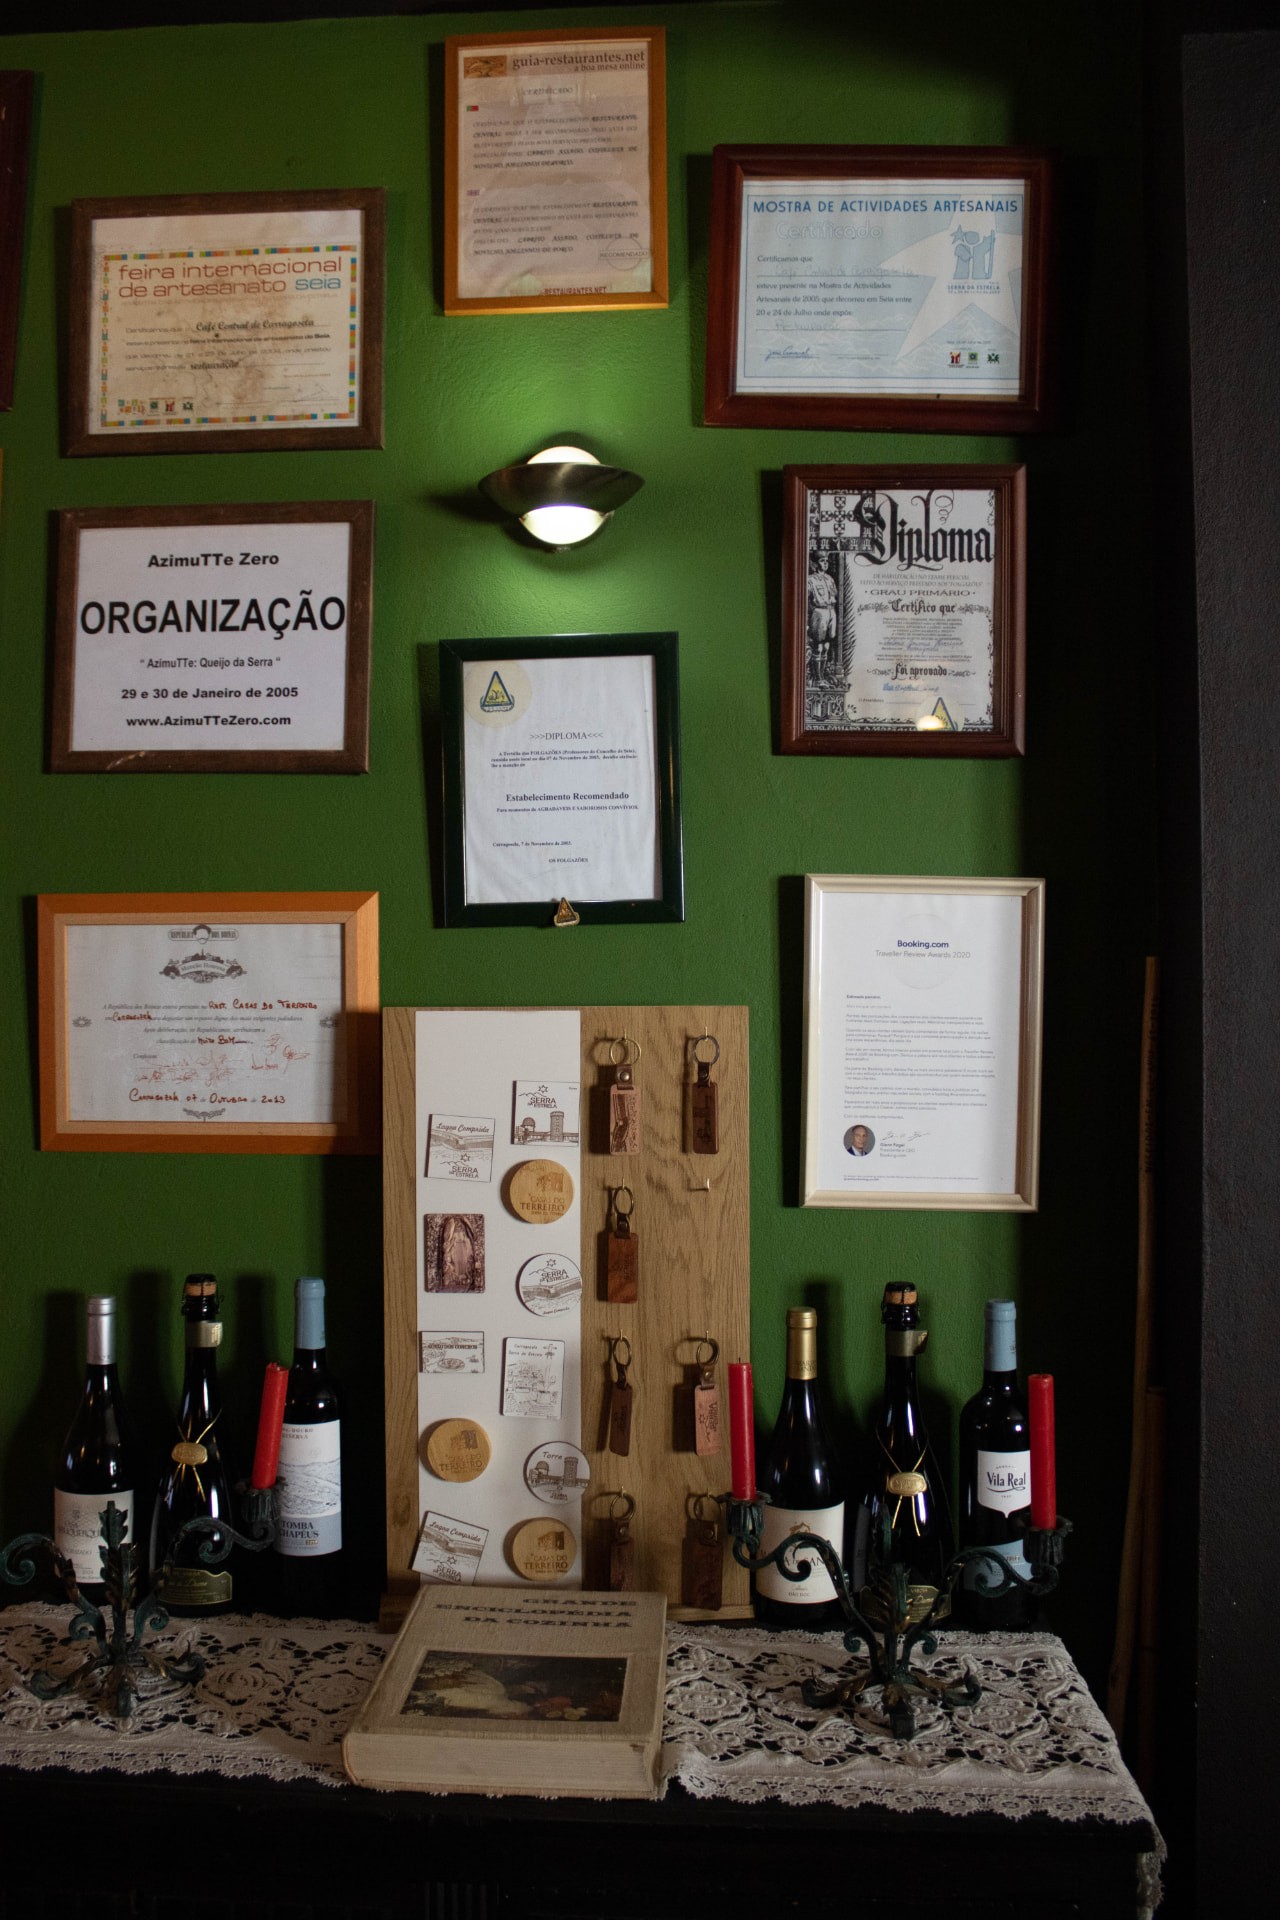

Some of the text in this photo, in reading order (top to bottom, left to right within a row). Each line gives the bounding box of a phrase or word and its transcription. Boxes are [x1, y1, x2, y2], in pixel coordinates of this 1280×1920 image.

[512, 51, 646, 70] guia-restaurantes.net
[619, 62, 646, 70] online
[753, 200, 1018, 213] MOSTRA DE ACTIVIDADES ARTESANAIS
[775, 218, 884, 240] Certificado
[119, 256, 342, 281] feira internacional
[119, 274, 342, 298] de artesanato seia
[778, 283, 806, 291] presente
[196, 320, 217, 332] Café
[217, 319, 249, 331] Central
[853, 490, 993, 571] Diploma
[148, 552, 279, 567] AzimuTTe Zero
[909, 588, 971, 597] PRIMÁRIO
[888, 598, 956, 617] Certifico que
[80, 589, 345, 640] ORGANIZAÇÃO
[147, 656, 273, 669] AzimuTTe: Queijo da Serra
[910, 665, 948, 678] aprovado
[121, 689, 137, 699] 29
[153, 688, 169, 699] 30
[172, 688, 188, 698] de
[192, 688, 242, 698] Janeiro
[245, 687, 261, 698] de
[266, 687, 298, 698] 2005
[126, 715, 291, 726] www.AzimuTTeZero.com
[506, 792, 630, 802] Estabelecimento Recomendado
[897, 940, 950, 949] Booking.com
[530, 1096, 556, 1104] SERRA
[436, 1122, 490, 1134] Lagoa Comprida
[452, 1165, 478, 1174] SERRA
[520, 1202, 565, 1211] TERREIRO
[541, 1269, 568, 1279] SERRA
[543, 1451, 563, 1460] Torre
[986, 1471, 1026, 1488] Vila Real
[430, 1521, 481, 1543] Lagoa Comprida
[437, 1565, 462, 1578] SERRA
[524, 1562, 568, 1570] TERREIRO
[523, 1598, 636, 1606] GRANDE
[434, 1604, 632, 1617] ENCICLOPÉDIA
[506, 1618, 632, 1627] COZINHA
